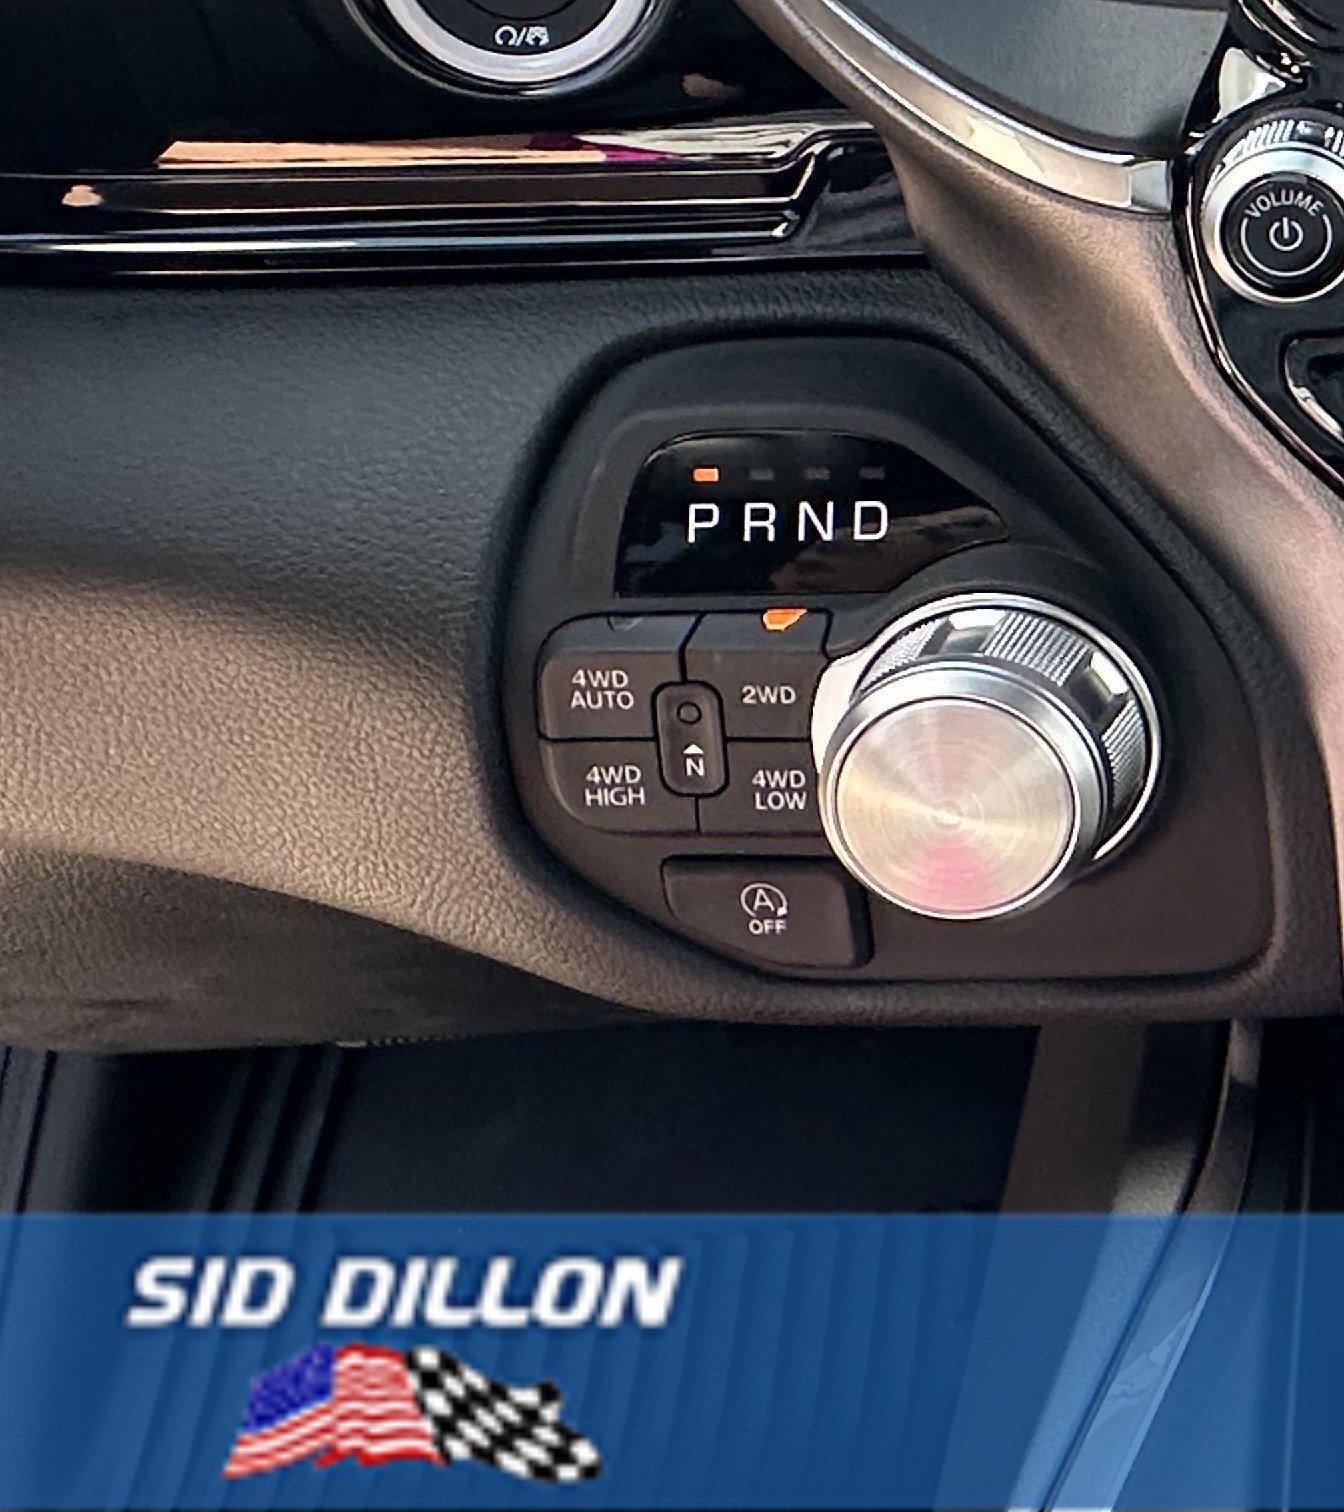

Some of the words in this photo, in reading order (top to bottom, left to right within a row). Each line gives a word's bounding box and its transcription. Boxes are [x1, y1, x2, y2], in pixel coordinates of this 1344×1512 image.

[1244, 188, 1325, 220] VOLUME
[687, 502, 720, 543] P
[743, 502, 776, 542] R
[797, 500, 834, 541] N
[853, 500, 889, 540] D
[571, 668, 629, 689] 4WD
[570, 689, 634, 710] AUTO
[741, 684, 797, 705] 2WD
[585, 764, 641, 785] 4WD
[685, 755, 705, 778] N
[751, 768, 806, 789] 4WD
[584, 785, 646, 807] HIGH
[753, 789, 807, 810] LOW
[747, 917, 787, 936] OFF
